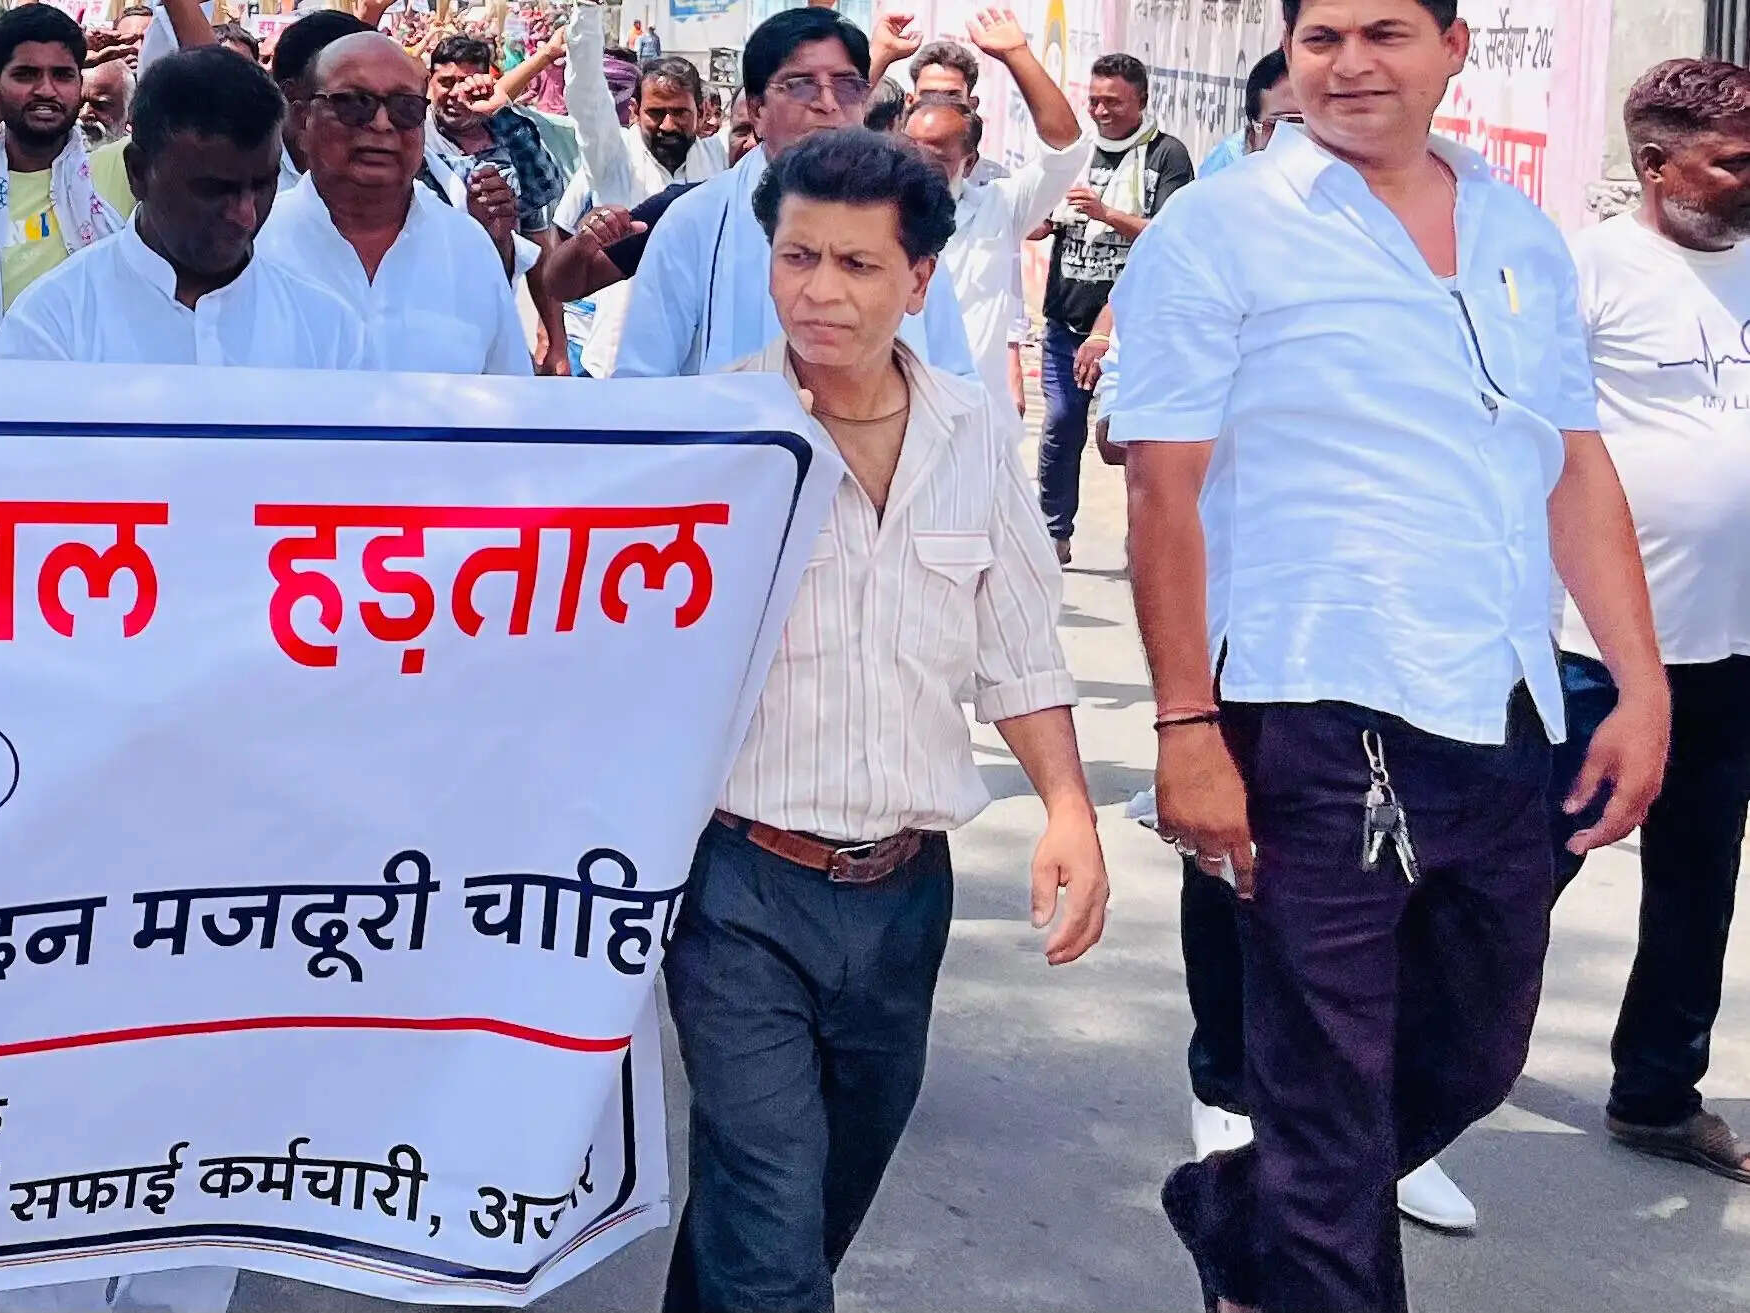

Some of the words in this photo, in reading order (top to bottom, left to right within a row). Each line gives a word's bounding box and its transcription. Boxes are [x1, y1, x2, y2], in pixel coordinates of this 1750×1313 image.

[254, 503, 730, 675] हड़ताल
[133, 849, 440, 982] मजदूरी
[9, 1141, 190, 1219] सफाई
